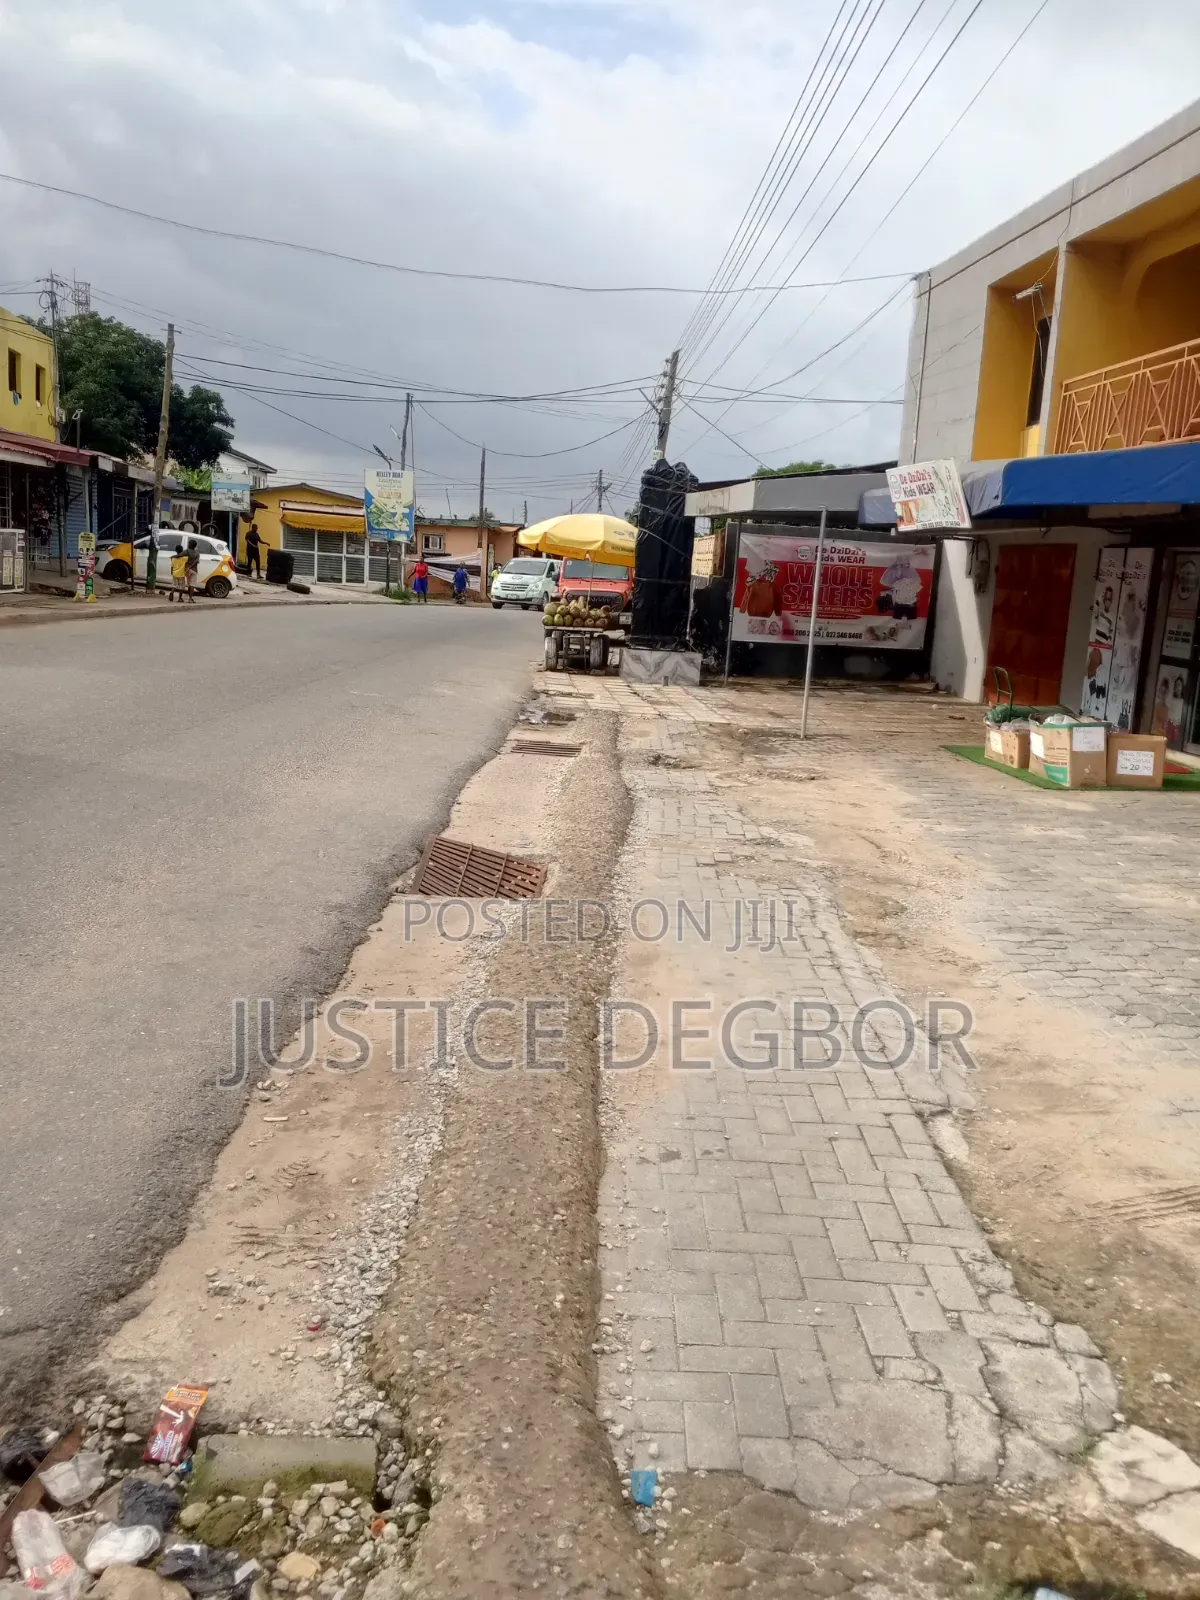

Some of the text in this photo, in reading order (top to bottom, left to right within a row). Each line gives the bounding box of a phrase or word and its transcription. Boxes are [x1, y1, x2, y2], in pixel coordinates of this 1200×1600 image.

[902, 486, 917, 498] Kids
[916, 482, 937, 496] WEAR
[830, 546, 867, 556] DziDzi's
[838, 555, 866, 565] WEAR
[787, 562, 874, 589] WHOLE
[782, 583, 874, 609] SALERS
